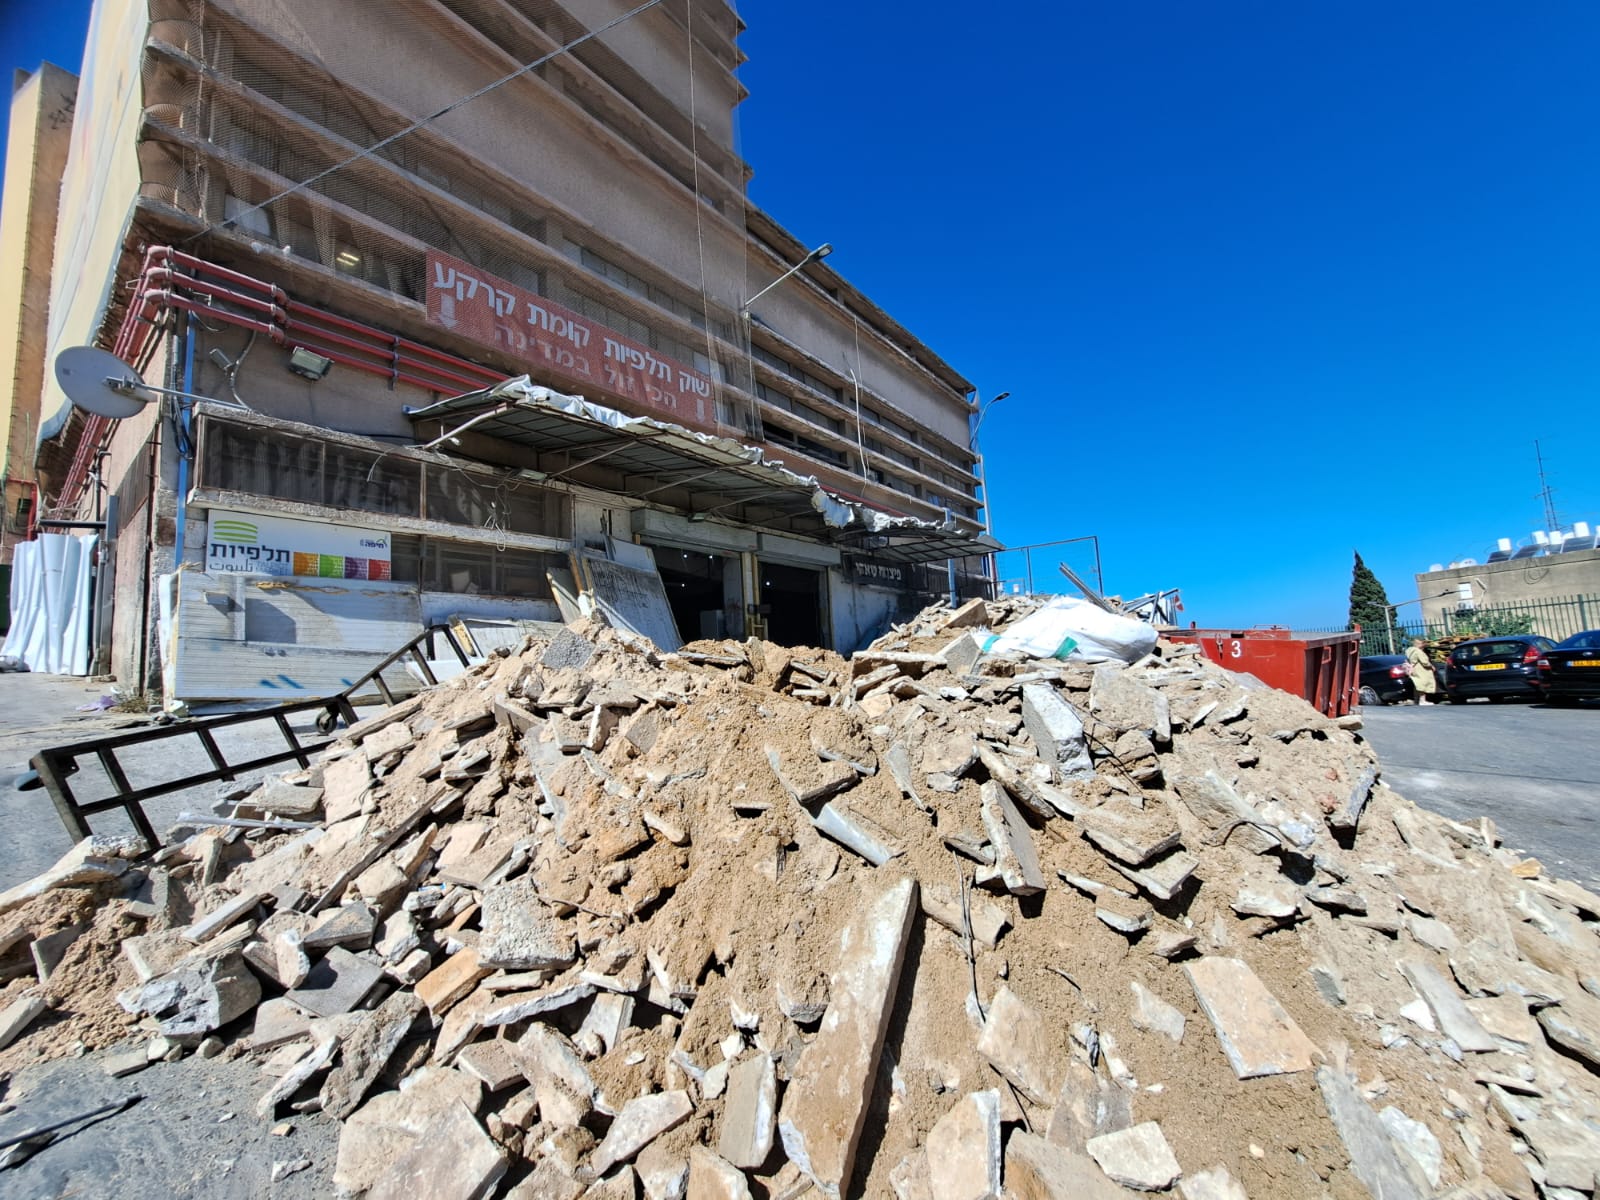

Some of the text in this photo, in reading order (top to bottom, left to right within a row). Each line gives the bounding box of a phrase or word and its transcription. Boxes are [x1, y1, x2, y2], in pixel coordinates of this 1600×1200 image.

[434, 261, 710, 398] שוק תלפיות קומת קרקע
[495, 325, 591, 377] במדינה
[604, 364, 634, 393] זול
[210, 543, 290, 563] תלפיות
[1231, 640, 1241, 658] 3
